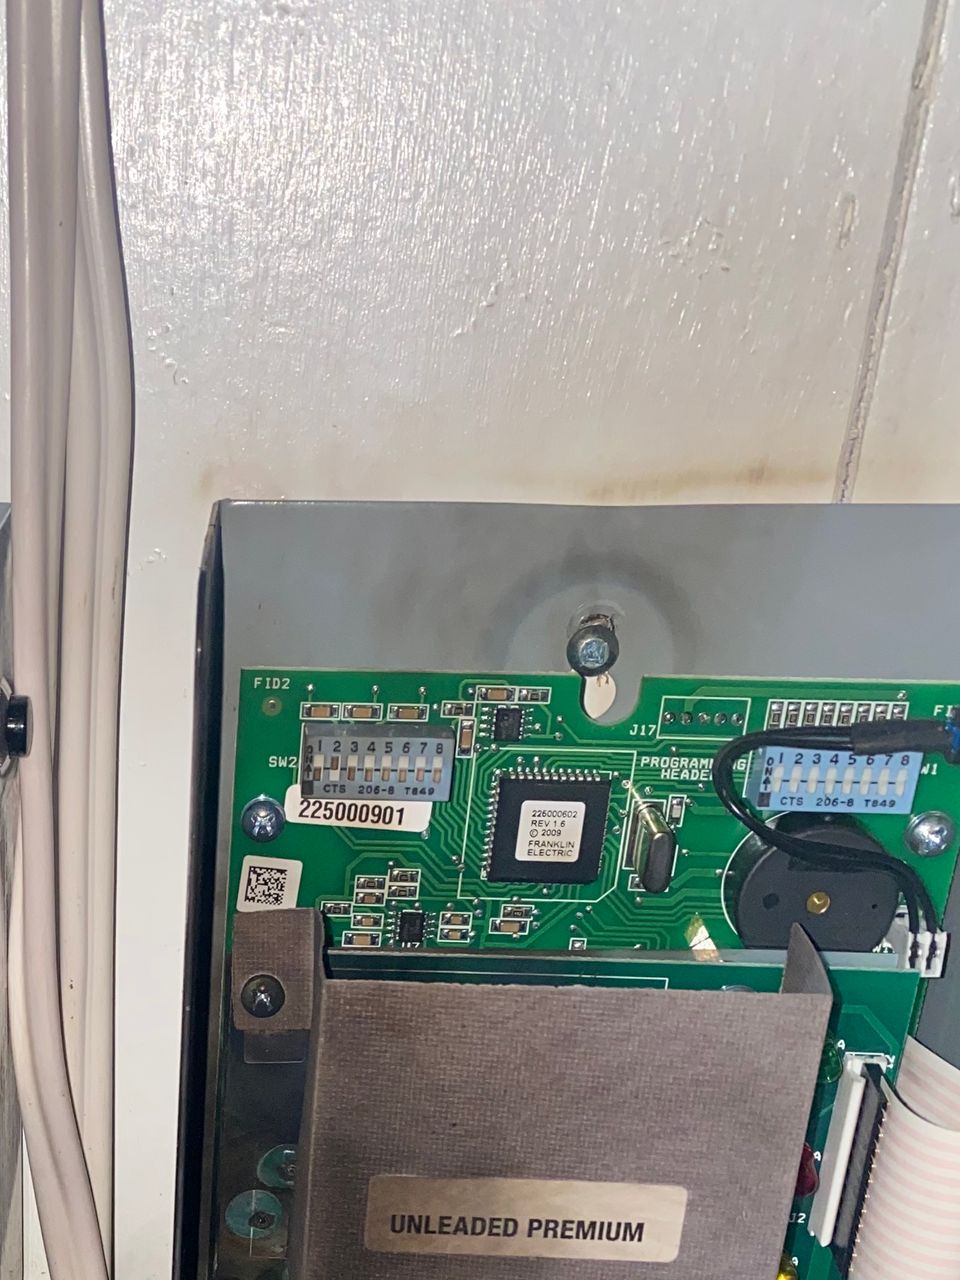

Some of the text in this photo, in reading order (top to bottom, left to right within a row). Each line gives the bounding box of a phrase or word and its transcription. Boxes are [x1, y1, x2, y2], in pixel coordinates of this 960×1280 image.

[253, 677, 290, 689] FID2
[629, 724, 657, 736] J17
[268, 756, 297, 768] SW2
[661, 769, 713, 781] HEADE
[323, 784, 435, 796] CTS 206-8 T849
[780, 796, 897, 808] CTS 206-8 T849
[298, 799, 406, 826] 225000901
[541, 829, 562, 837] 2009
[528, 840, 575, 848] FRANKLIN
[527, 848, 573, 857] ELECTRIC
[390, 1213, 645, 1243] UNLEADED PREMIUM
